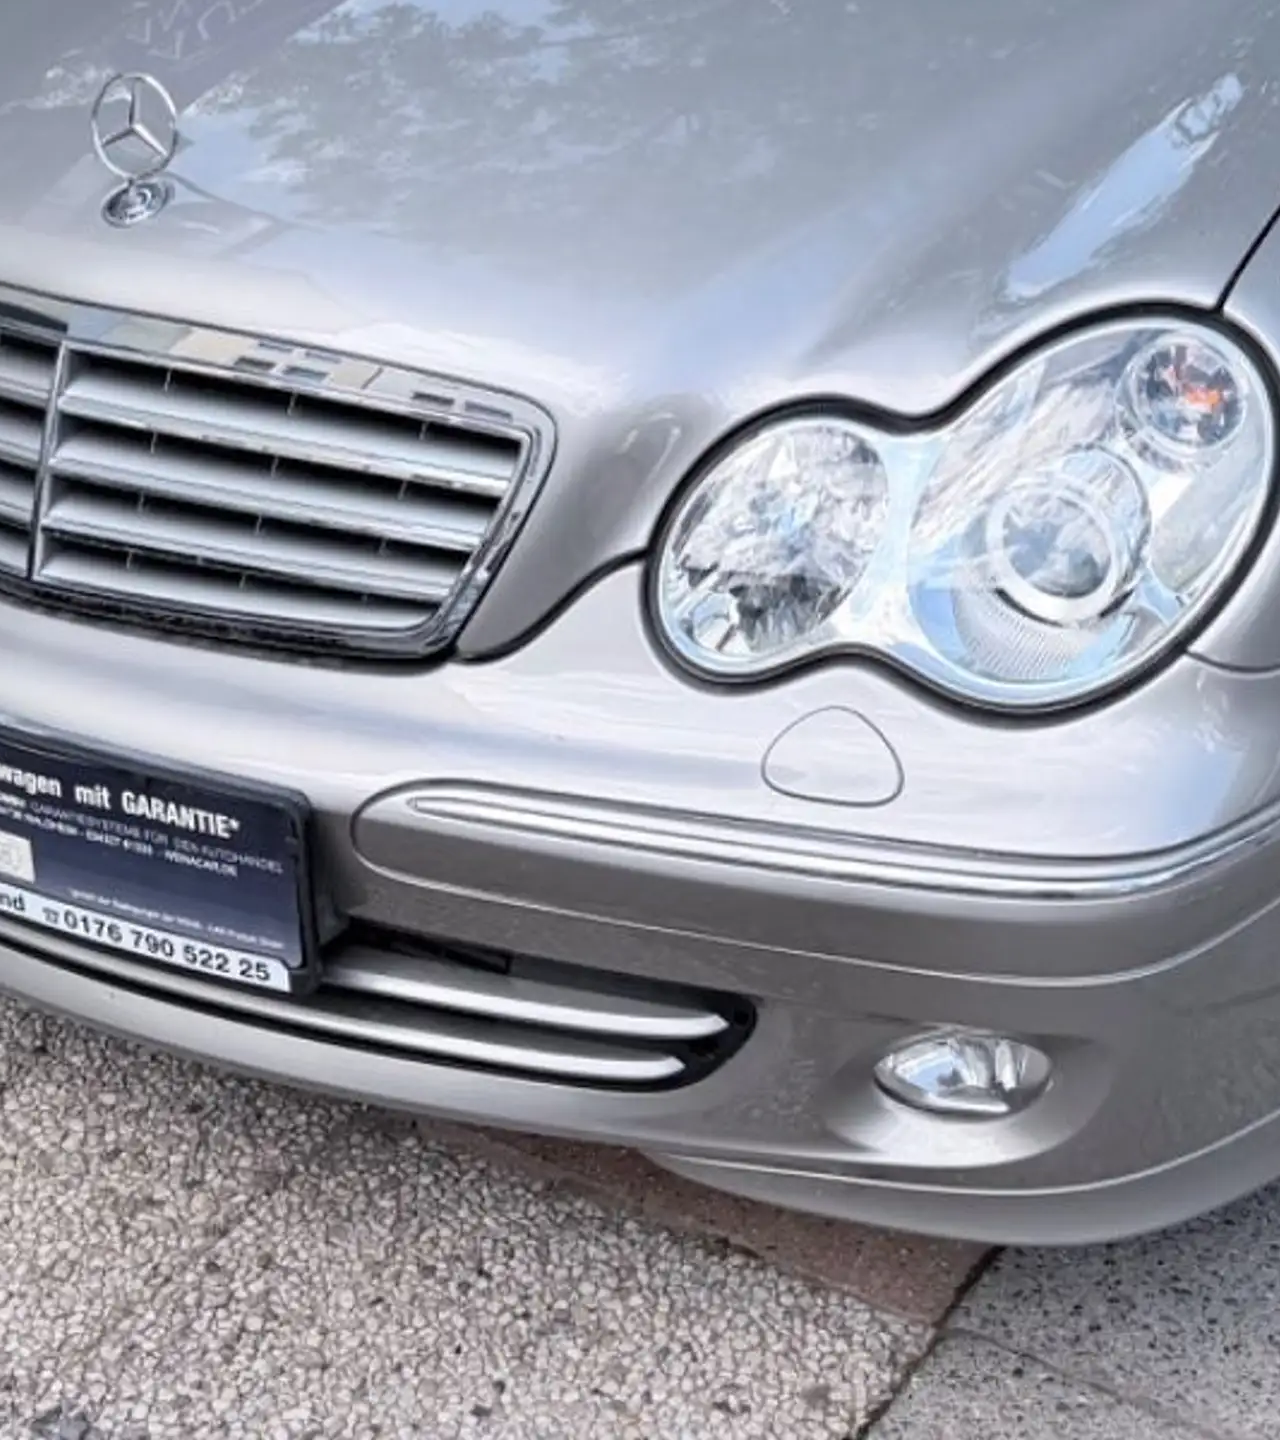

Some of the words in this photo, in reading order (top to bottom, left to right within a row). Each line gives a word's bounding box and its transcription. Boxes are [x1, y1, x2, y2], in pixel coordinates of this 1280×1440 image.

[74, 783, 112, 810] mit
[63, 909, 123, 944] 0176
[130, 928, 175, 958] 790
[183, 944, 232, 975] 522
[239, 958, 271, 982] 25
